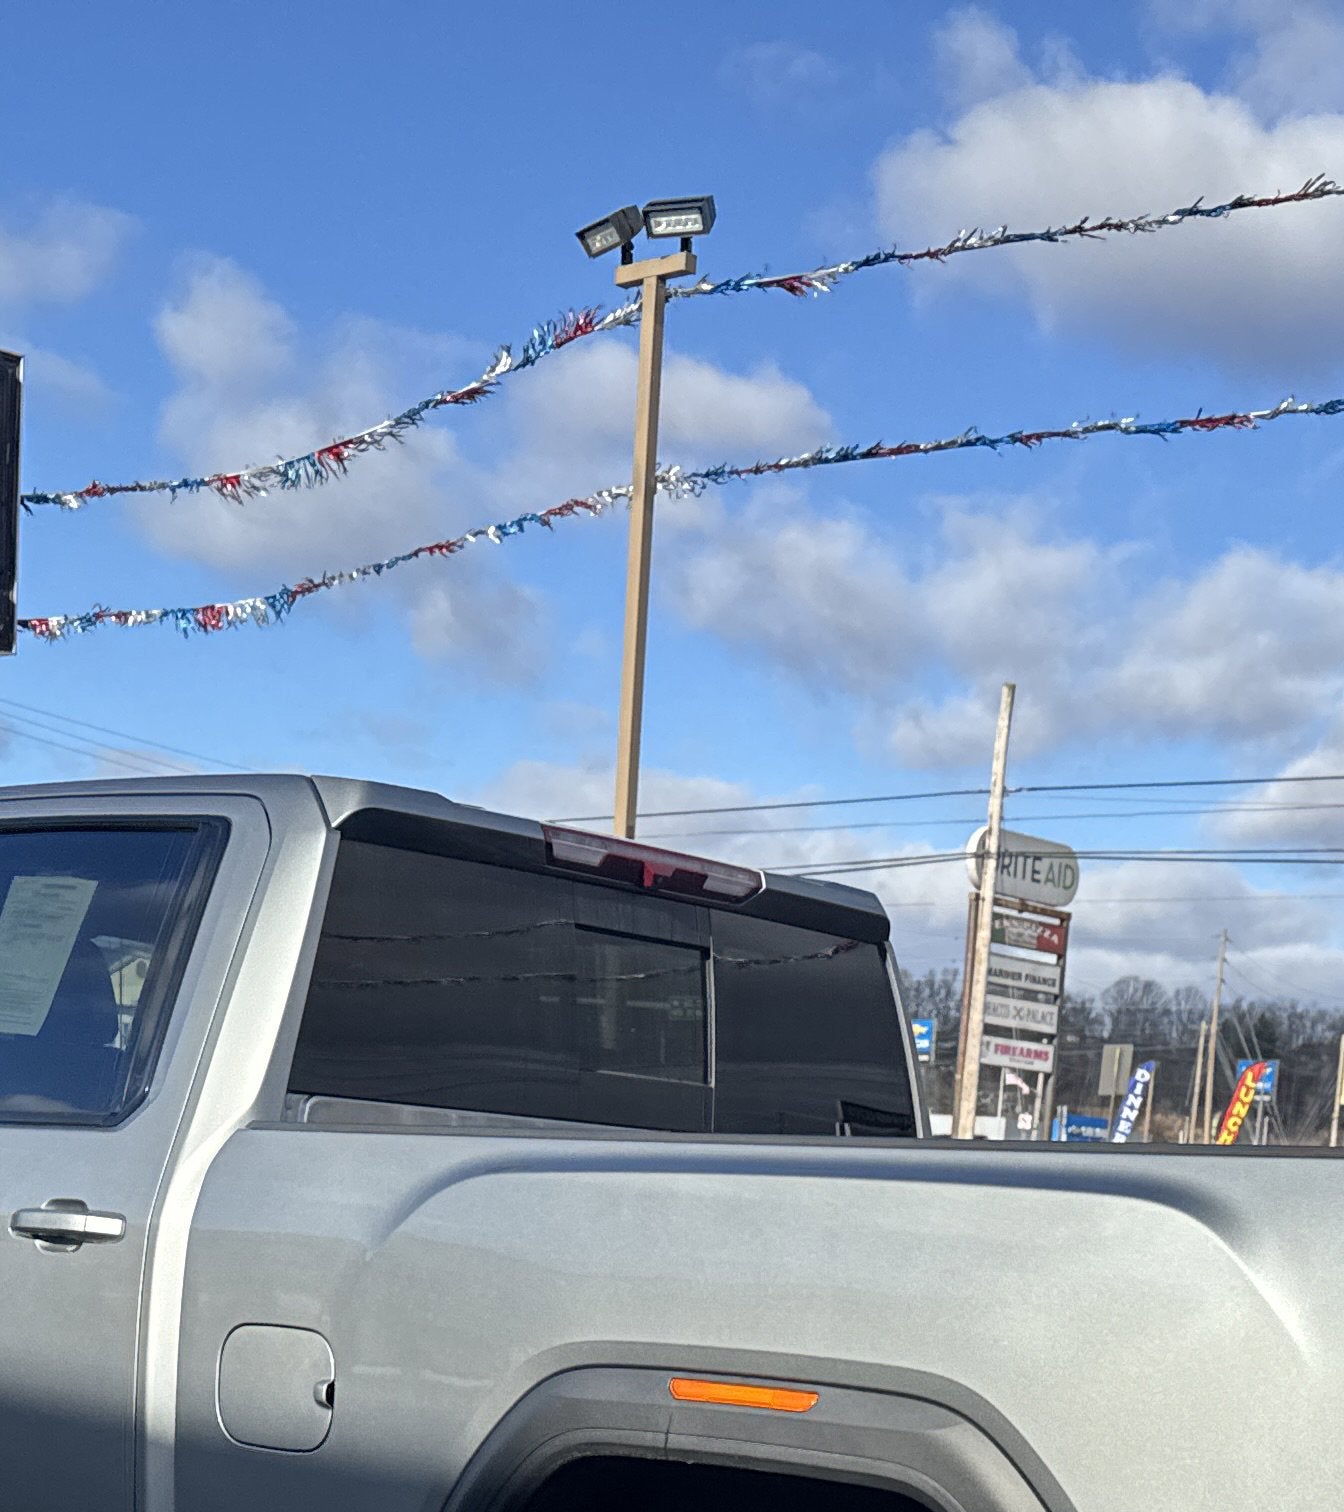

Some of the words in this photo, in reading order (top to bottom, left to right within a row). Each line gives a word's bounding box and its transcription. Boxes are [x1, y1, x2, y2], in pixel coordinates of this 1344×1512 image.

[1000, 849, 1042, 883] RITE
[1044, 861, 1076, 890] AID
[994, 1043, 1050, 1063] FIREARMS
[1216, 1071, 1256, 1145] LUNCH
